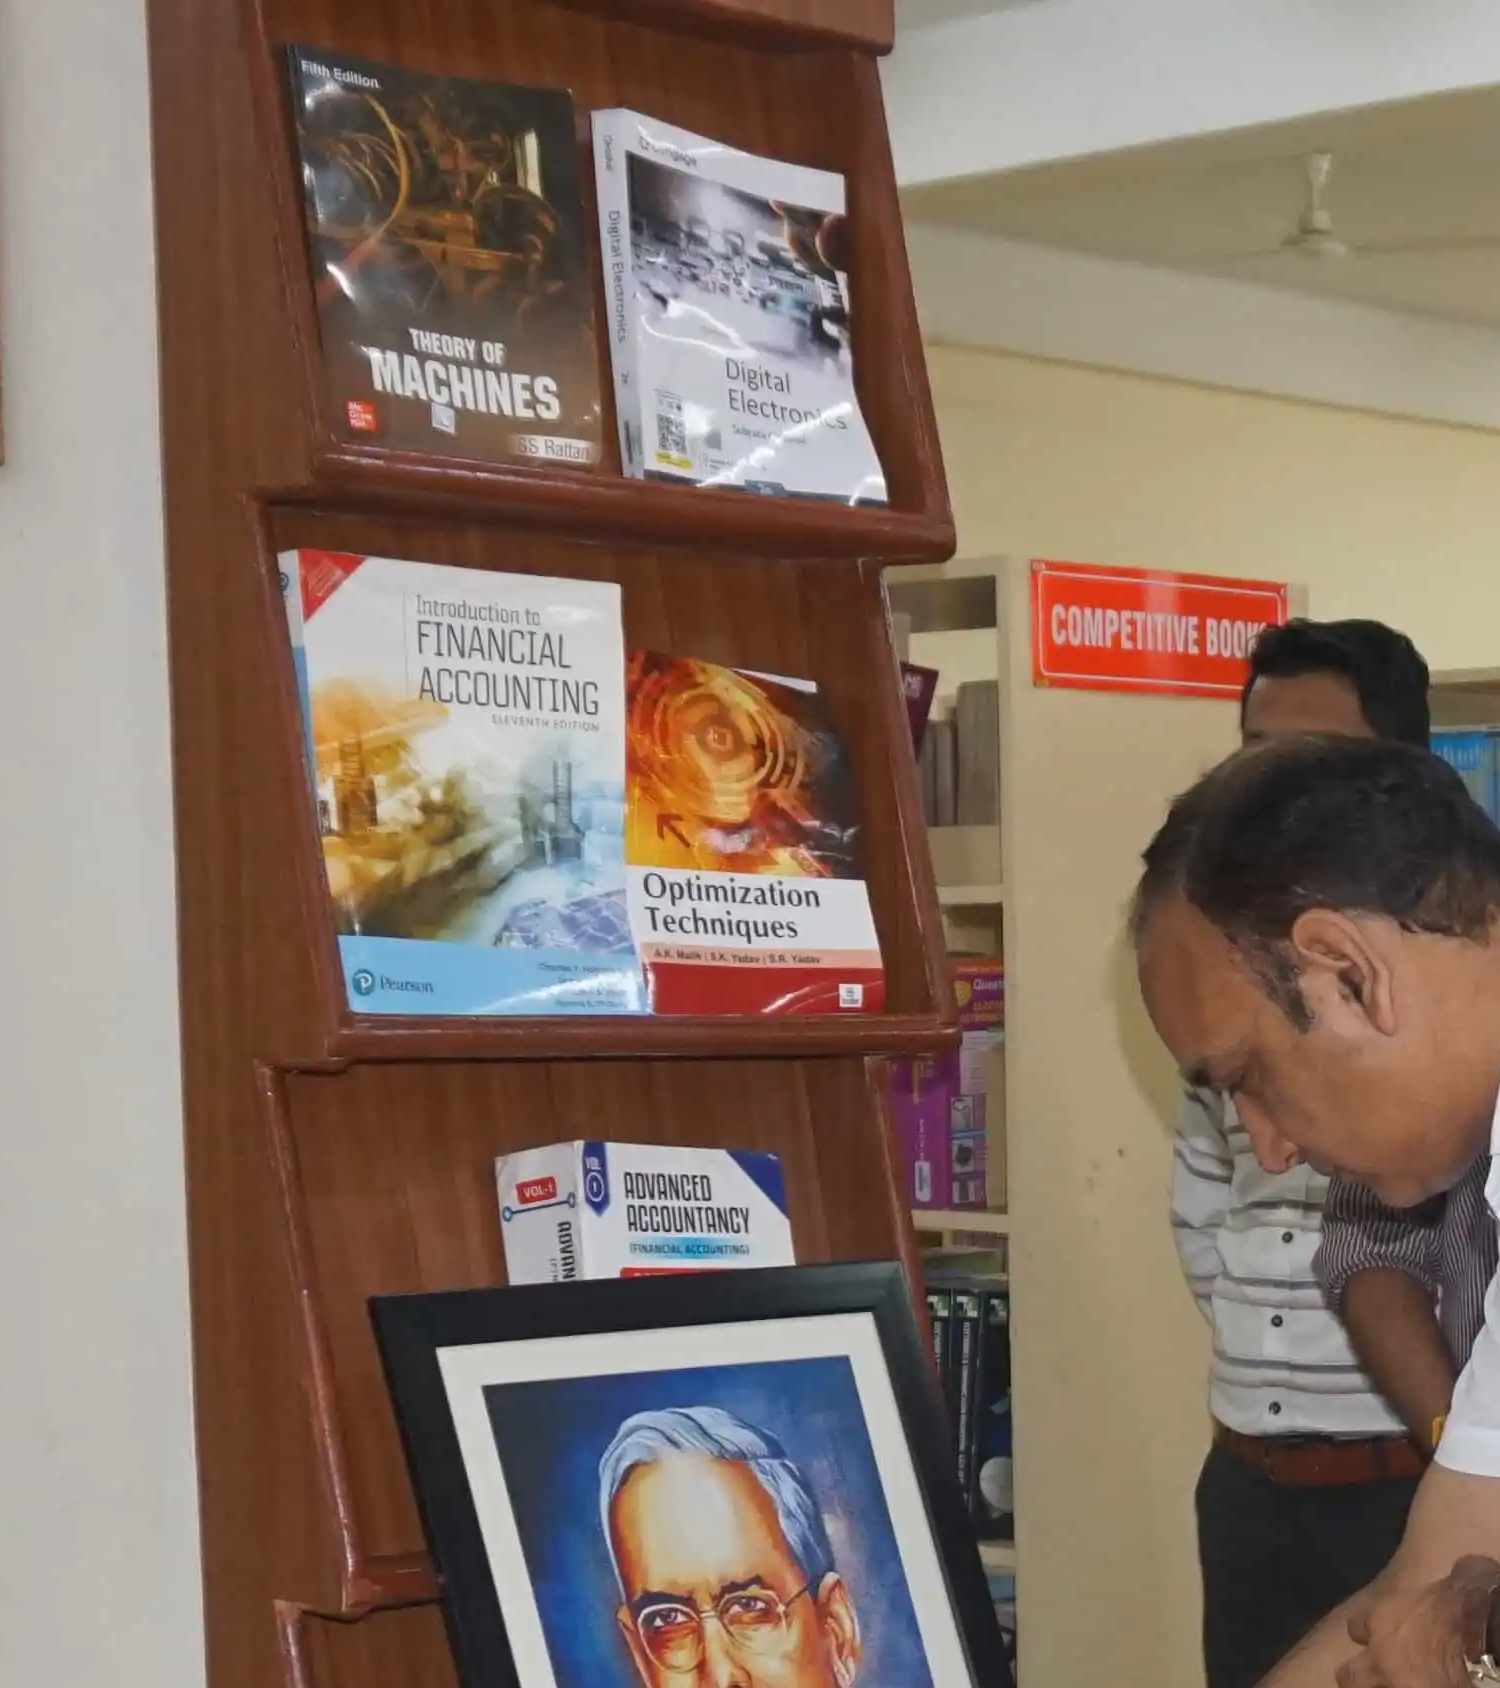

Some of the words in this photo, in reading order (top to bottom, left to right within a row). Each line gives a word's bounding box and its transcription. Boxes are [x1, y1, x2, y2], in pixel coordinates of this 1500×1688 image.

[301, 60, 330, 79] Fifth
[333, 67, 380, 89] Edition
[608, 210, 622, 258] Digital
[612, 261, 628, 344] Electronics
[409, 328, 474, 361] THEORY
[482, 341, 505, 366] OF
[366, 348, 561, 420] MACHINES
[725, 357, 790, 394] Digital
[728, 388, 848, 431] Electronics
[544, 438, 590, 460] Rattan
[416, 594, 520, 625] Introduction
[524, 606, 542, 627] to
[417, 619, 572, 669] FINANCIAL
[1051, 603, 1199, 656] COMPETITIVE
[1206, 616, 1266, 659] BOOK
[418, 665, 600, 717] ACCOUNTING
[492, 713, 550, 729] ELEVENTH
[553, 718, 600, 733] EDITION
[644, 873, 822, 909] Optimization
[644, 907, 798, 945] Techniques
[379, 975, 435, 996] Pearson
[624, 1172, 712, 1202] ADVANCED
[627, 1205, 750, 1234] ACCOUNTANCY
[630, 1242, 681, 1256] (FINANCIAL
[684, 1243, 749, 1256] ACCOUNTING)
